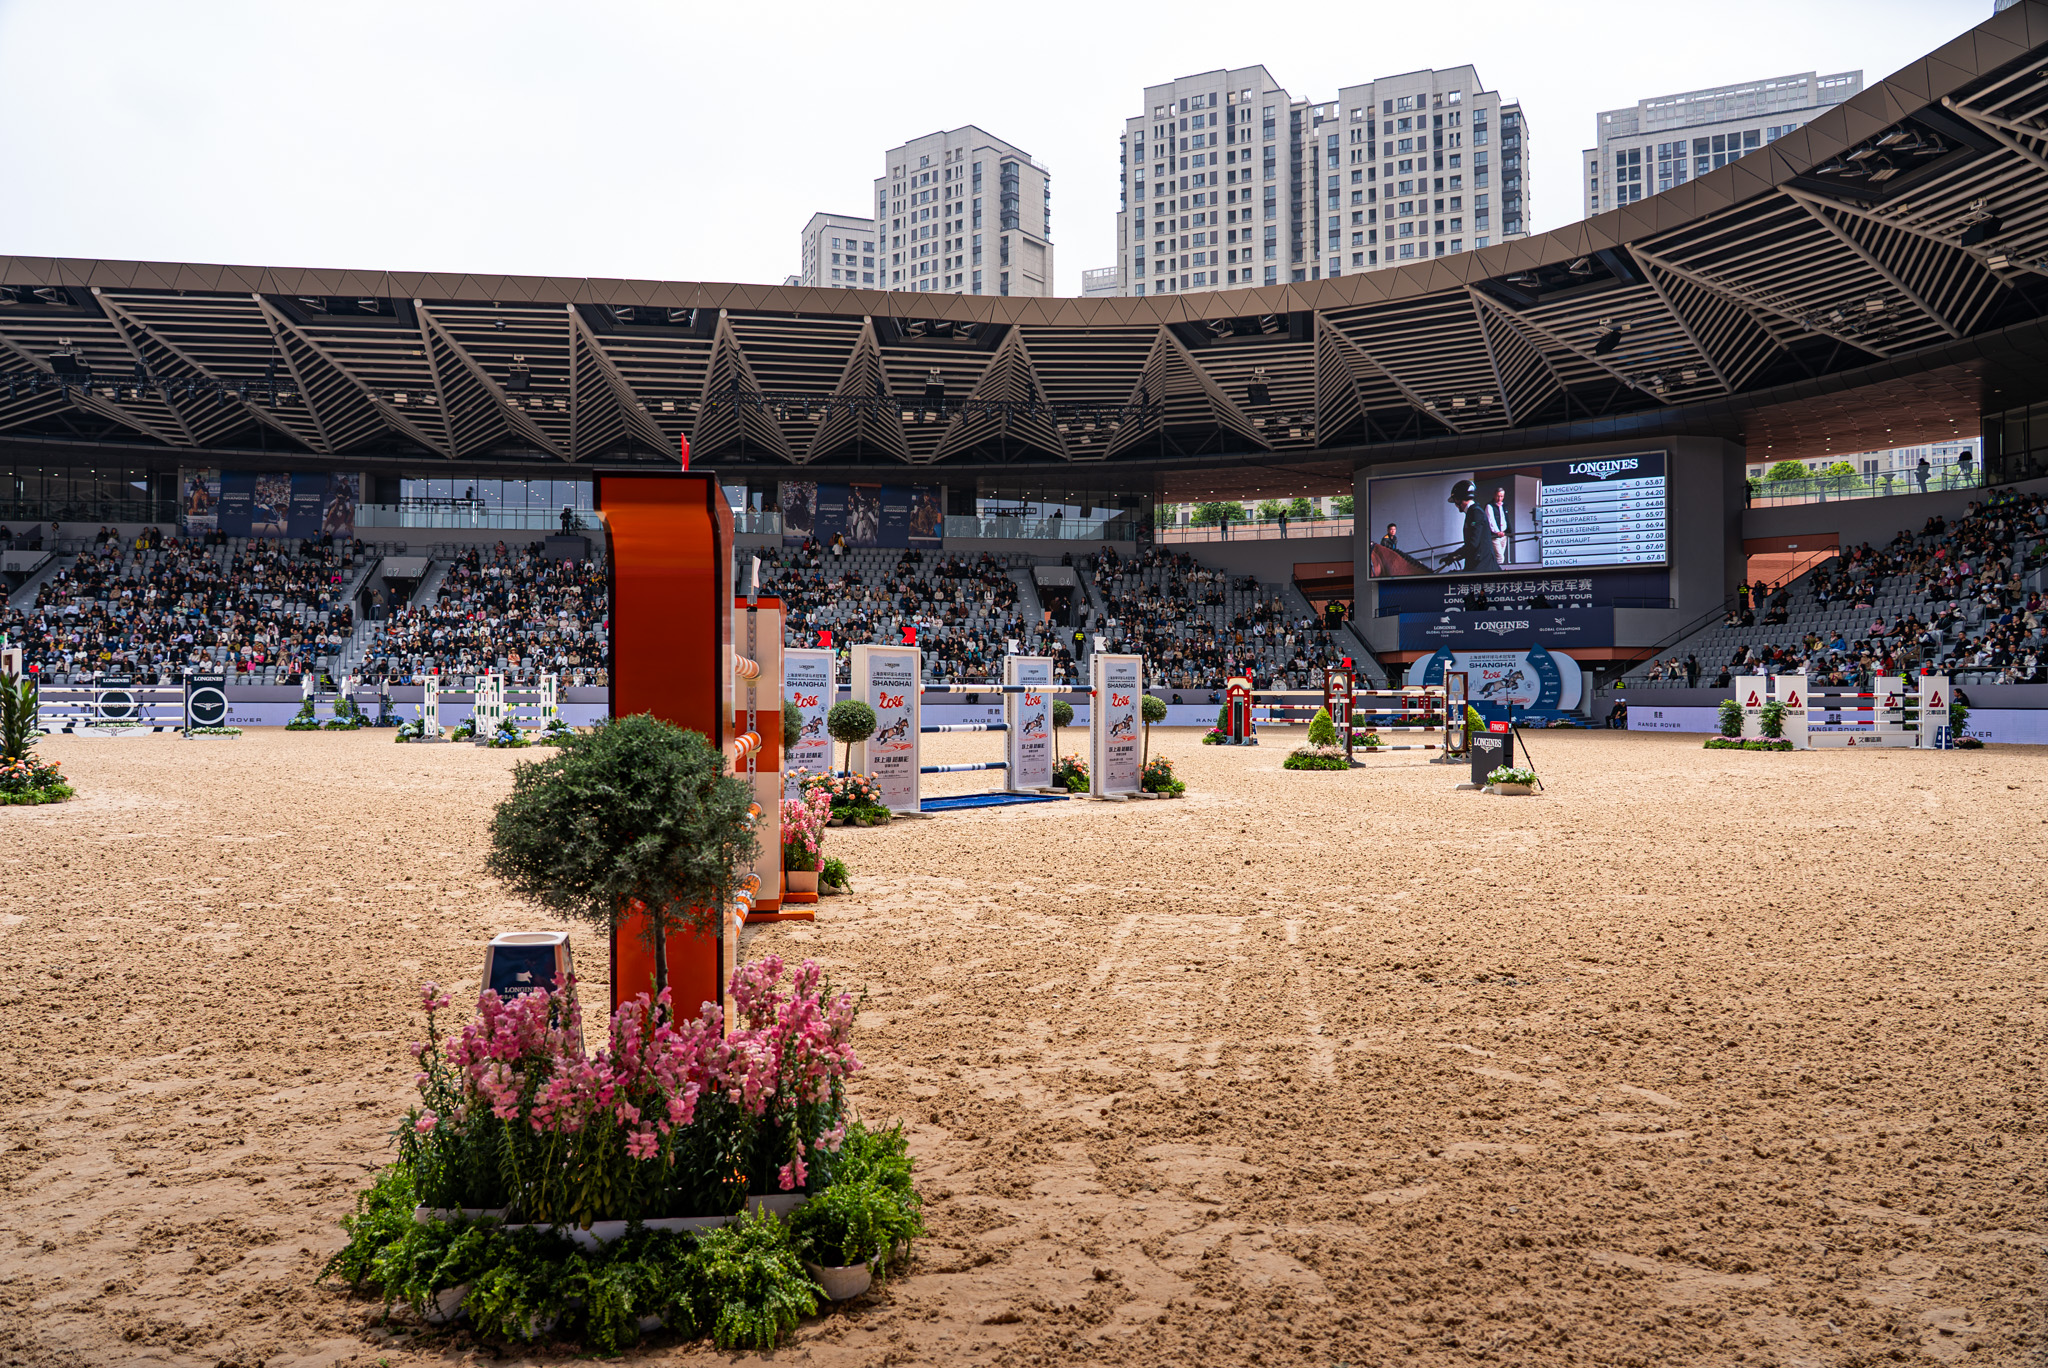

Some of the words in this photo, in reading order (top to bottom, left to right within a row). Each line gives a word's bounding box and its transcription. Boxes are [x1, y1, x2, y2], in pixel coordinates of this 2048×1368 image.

[1568, 458, 1639, 475] LONGINES
[1550, 516, 1598, 524] N.PHILIPPAERTS
[1474, 620, 1530, 630] LONGINES
[1491, 723, 1505, 732] FINISH
[1474, 737, 1502, 748] LONGINES
